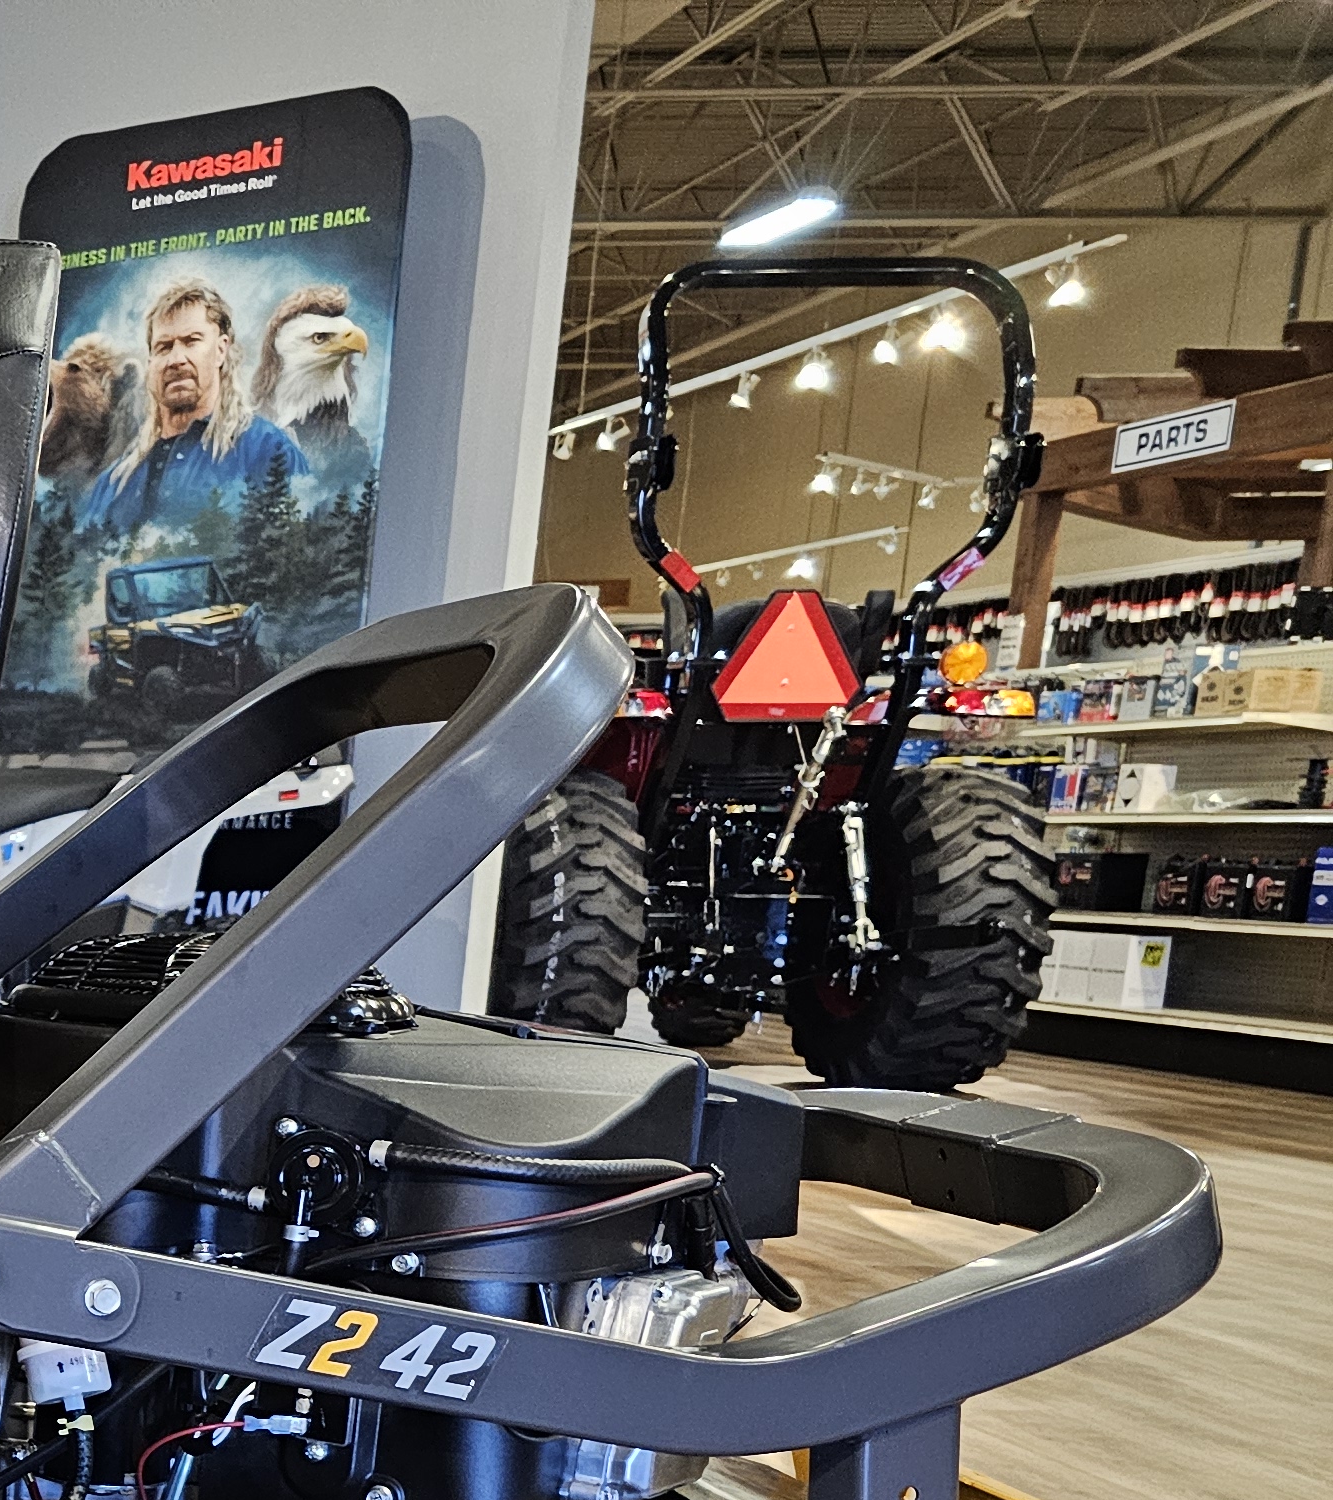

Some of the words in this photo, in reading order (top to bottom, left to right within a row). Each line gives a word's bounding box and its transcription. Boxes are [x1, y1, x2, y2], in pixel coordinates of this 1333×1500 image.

[127, 137, 283, 191] Kawasaki
[132, 196, 152, 210] Let
[153, 193, 173, 206] the
[175, 185, 208, 202] Good
[209, 181, 247, 196] Times
[61, 248, 108, 271] SINESS
[110, 245, 127, 262] IN
[129, 239, 157, 259] THE
[160, 232, 211, 254] FRONT.
[215, 222, 265, 246] PARTY
[268, 219, 285, 237] IN
[290, 214, 320, 234] THE
[323, 206, 371, 229] BACK.
[1136, 419, 1208, 456] PARTS
[255, 1298, 379, 1378] Z2
[379, 1323, 497, 1401] 42
